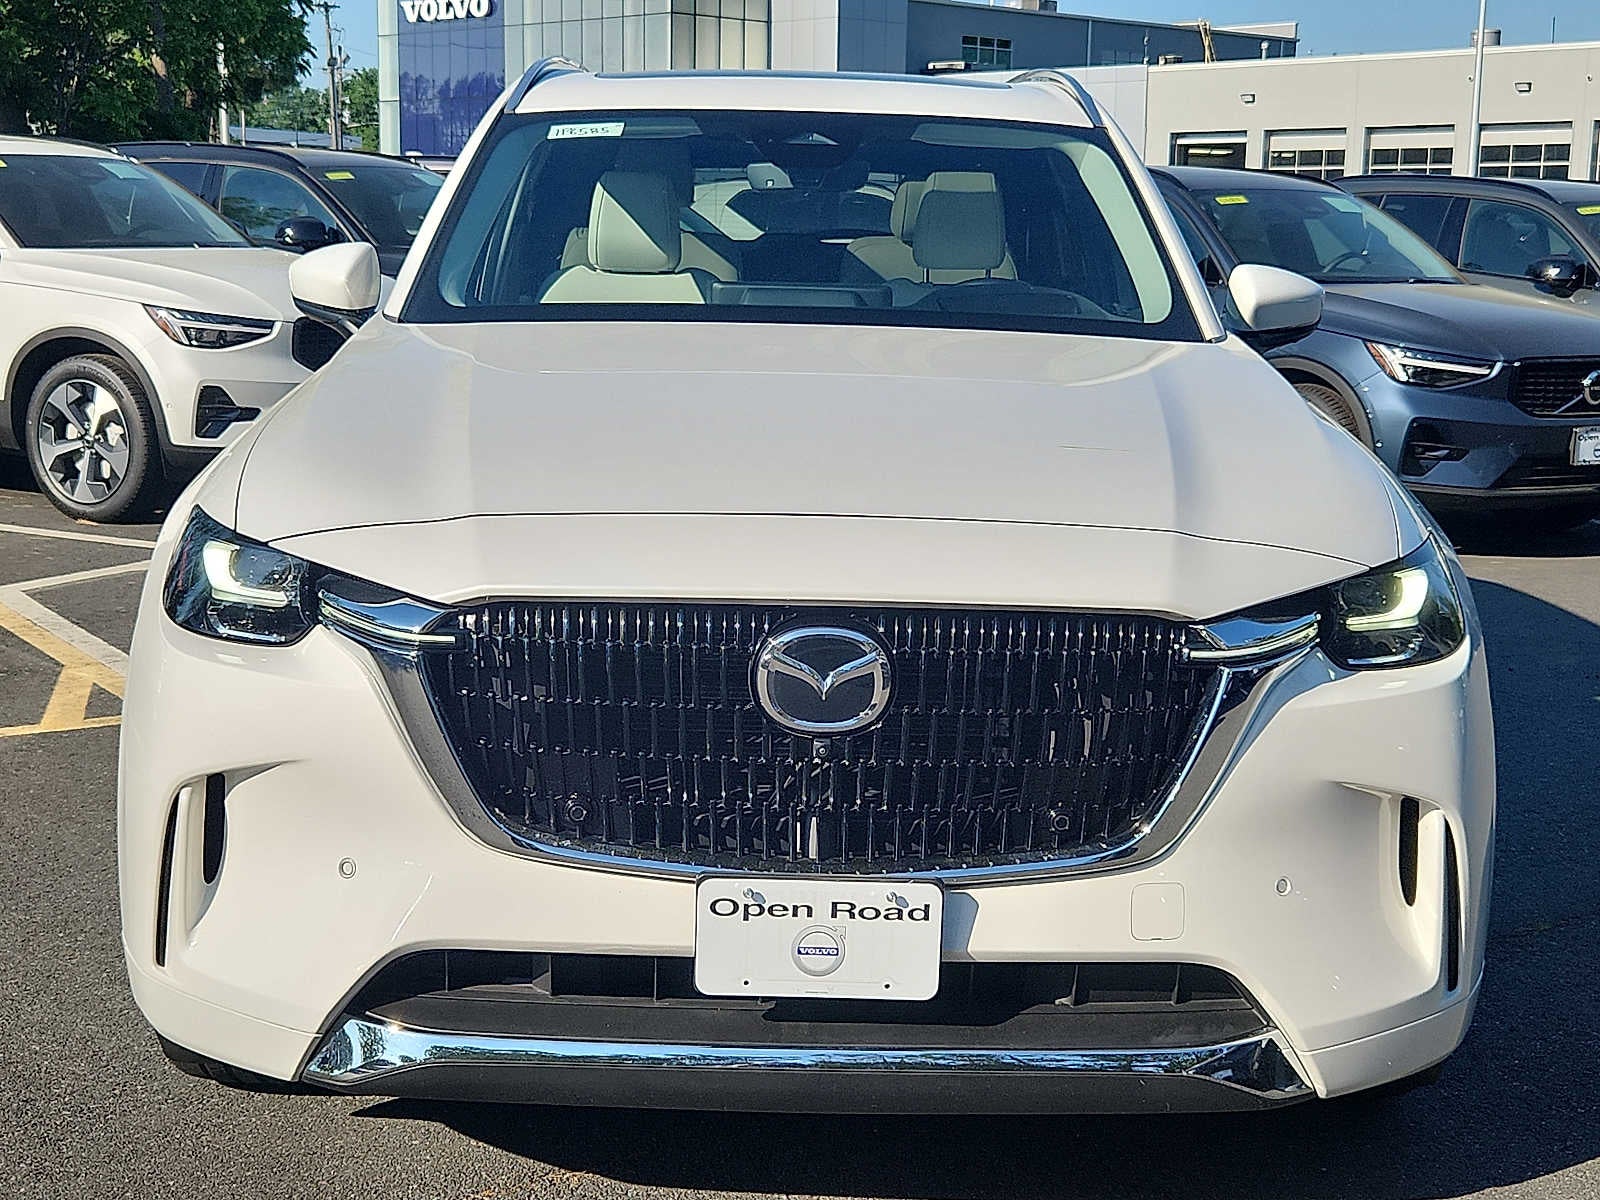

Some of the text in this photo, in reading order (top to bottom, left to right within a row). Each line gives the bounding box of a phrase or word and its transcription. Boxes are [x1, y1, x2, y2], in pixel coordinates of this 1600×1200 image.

[400, 0, 489, 23] VOLVO
[709, 898, 930, 922] Open Road
[798, 947, 838, 955] VOLVO
